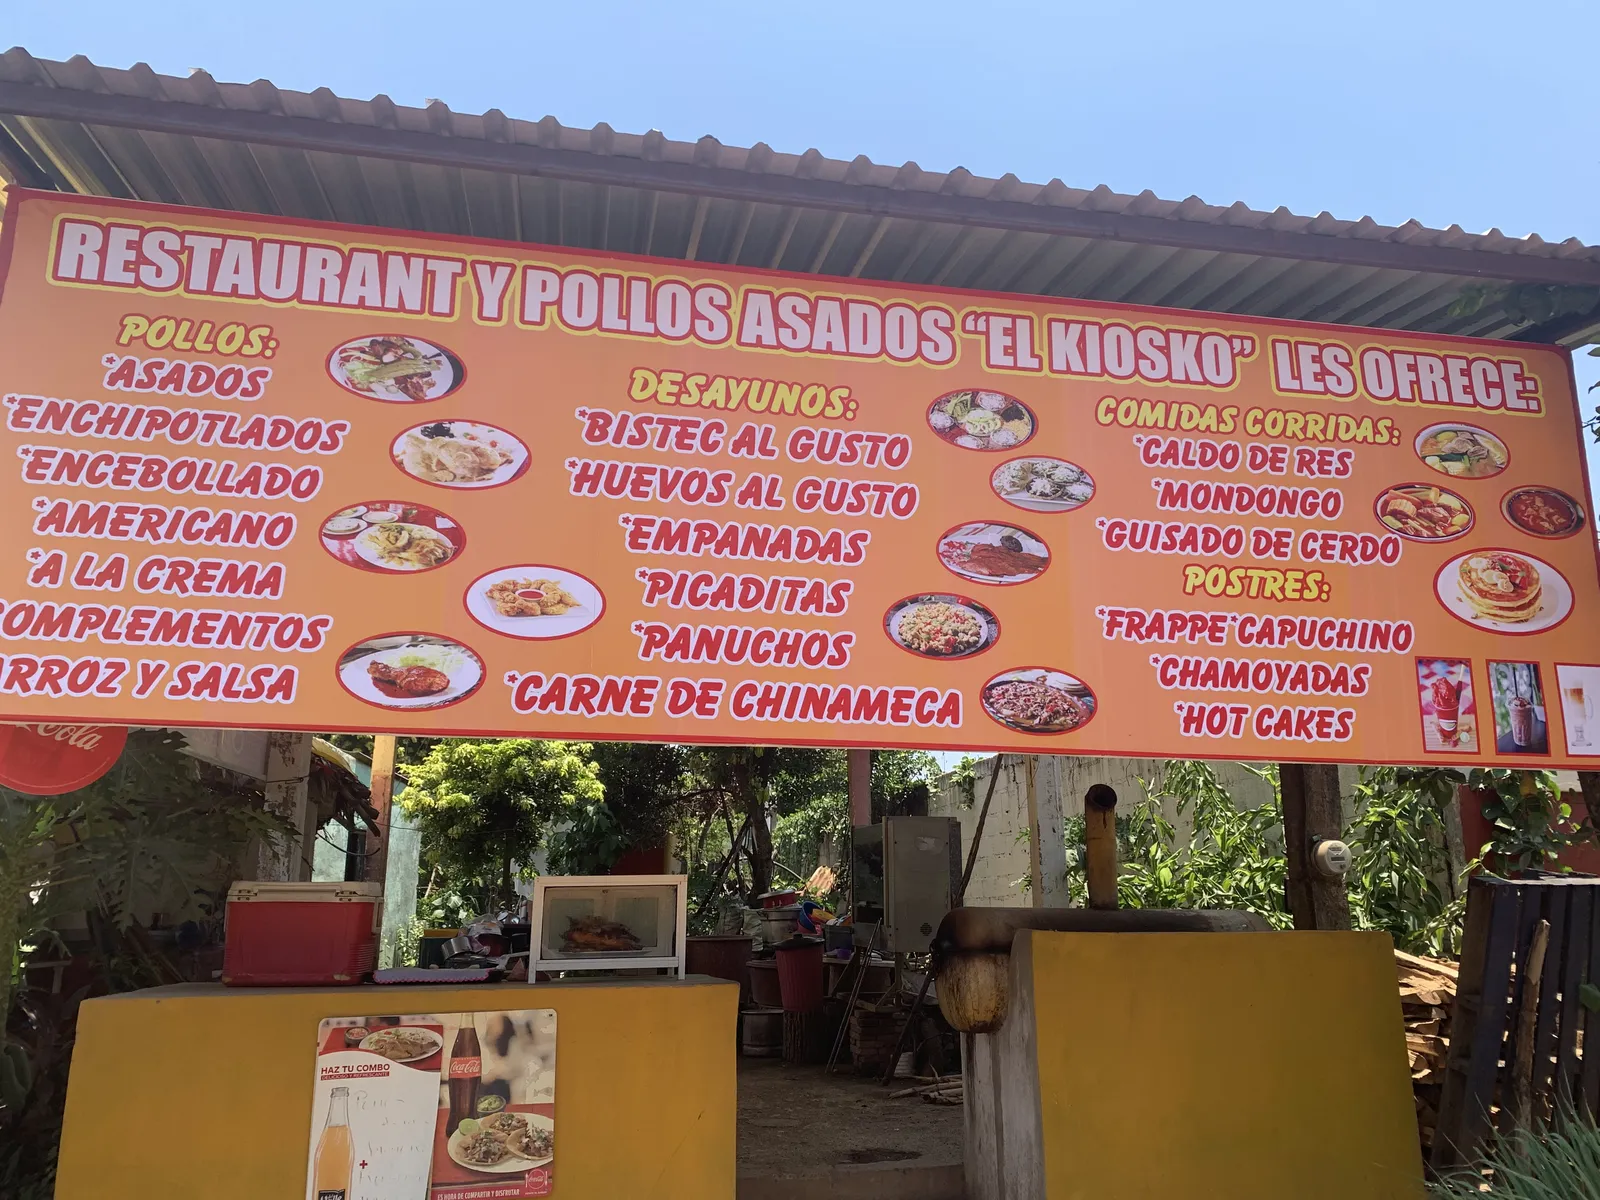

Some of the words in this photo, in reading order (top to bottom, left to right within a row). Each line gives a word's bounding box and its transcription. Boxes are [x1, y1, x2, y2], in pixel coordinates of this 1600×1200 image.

[55, 220, 464, 316] RESTAURANT
[470, 262, 515, 321] Y
[522, 265, 733, 346] POLLOS
[740, 287, 956, 364] ASADOS
[1272, 341, 1354, 395] LES
[1361, 349, 1542, 411] OFRECE:
[119, 314, 280, 359] POLLOS:
[630, 368, 858, 420] DESAYUNOS:
[1097, 397, 1236, 434] COMIDAS
[1245, 409, 1401, 445] CORRIDAS:
[730, 423, 777, 458] AL
[788, 428, 912, 468] GUSTO
[1248, 444, 1287, 475] DE
[1296, 448, 1353, 477] RES
[738, 474, 784, 509] AL
[794, 480, 918, 518] GUSTO
[1253, 530, 1292, 558] DE
[1300, 534, 1401, 565] CERDO
[74, 555, 126, 589] LA
[137, 560, 284, 597] CREMA
[1184, 565, 1331, 601] POSTRES:
[0, 602, 332, 650] OMPLEMENTOS
[0, 657, 126, 696] RROZ
[134, 662, 166, 696] Y
[168, 663, 297, 702] SALSA
[667, 681, 726, 717] DE
[731, 684, 962, 726] CHINAMECA
[1255, 707, 1355, 740] CAKES
[321, 1066, 340, 1075] HAZ
[342, 1065, 355, 1073] TU
[356, 1063, 391, 1072] COMBO
[465, 1190, 490, 1199] COMPARTIR
[495, 1188, 520, 1196] DISFRUTAR
